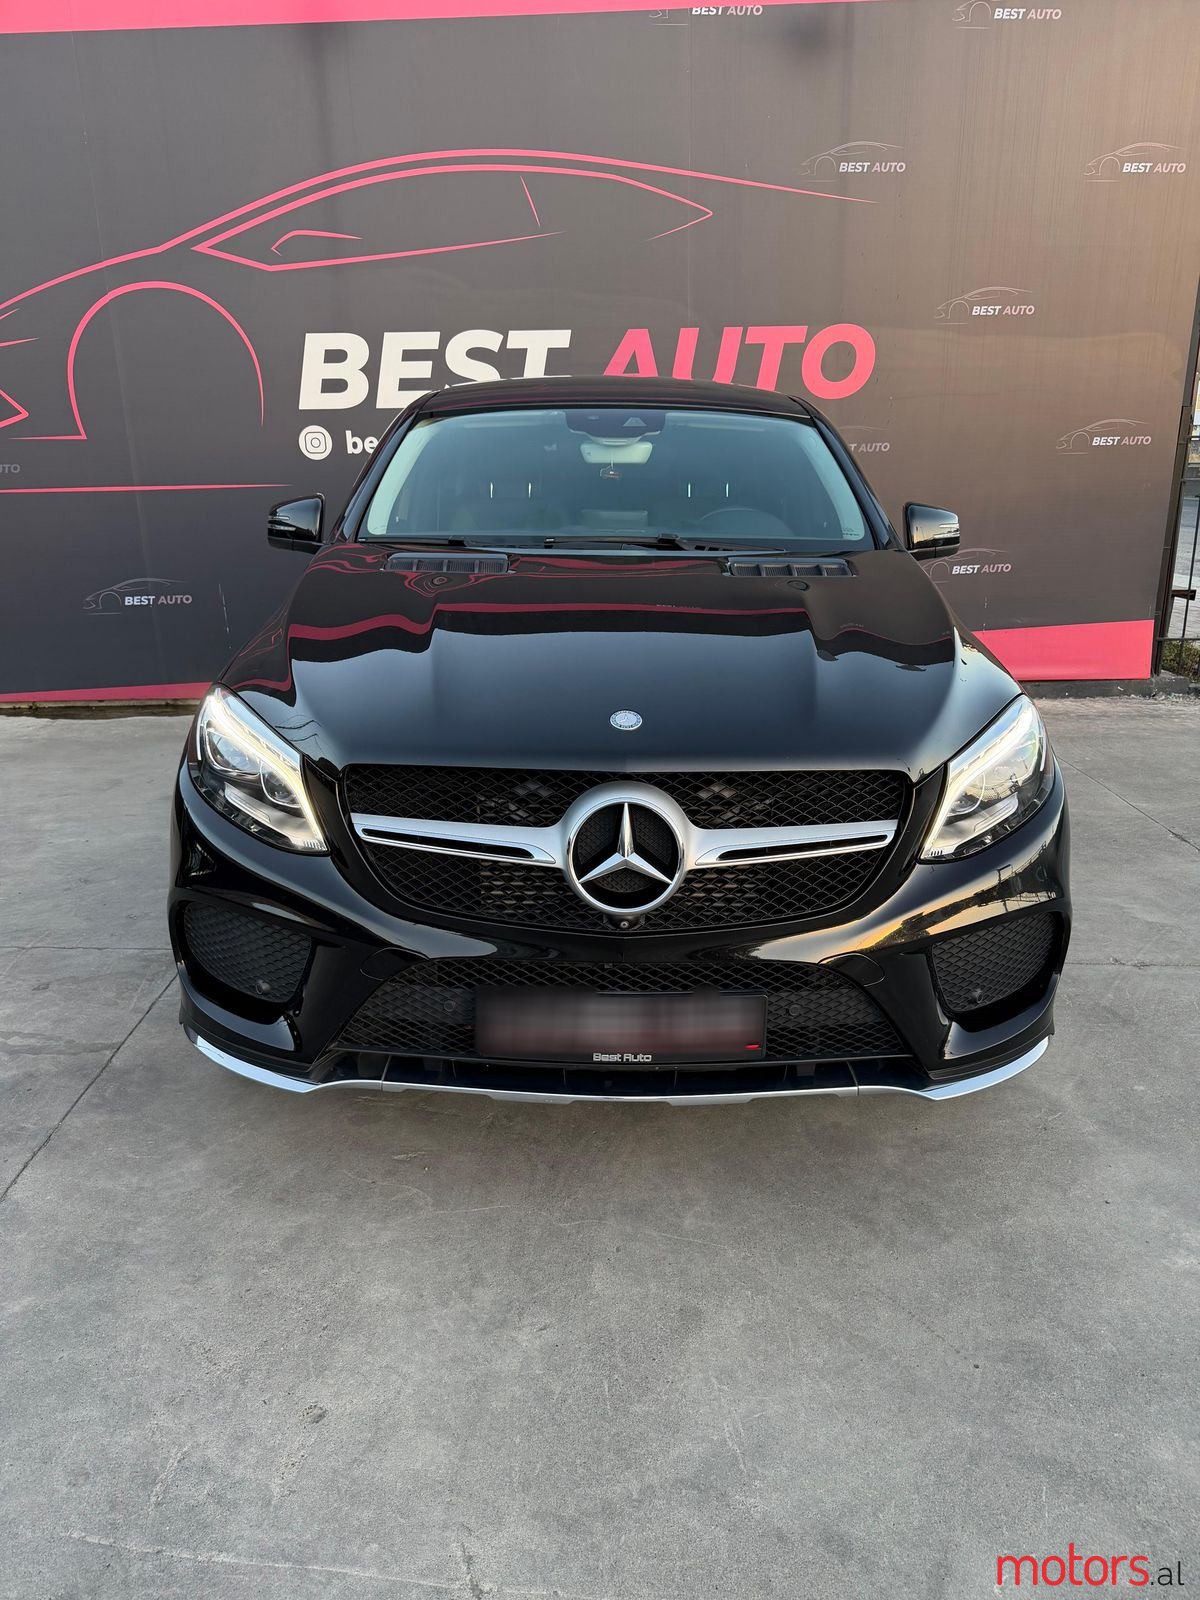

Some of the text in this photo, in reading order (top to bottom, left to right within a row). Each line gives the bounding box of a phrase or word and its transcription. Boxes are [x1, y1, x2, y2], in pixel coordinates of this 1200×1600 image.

[691, 5, 763, 16] BEST AUTO
[993, 7, 1062, 20] BEST AUTO
[838, 161, 906, 174] BEST AUTO
[1122, 161, 1186, 174] BEST AUTO
[971, 304, 1035, 316] BEST AUTO
[299, 323, 876, 410] BEST AUTO
[858, 442, 890, 452] AUTO
[1091, 435, 1152, 447] BEST AUTO
[951, 563, 1012, 575] BEST AUTO
[124, 594, 193, 606] BEST AUTO
[593, 1052, 652, 1062] Best Auto
